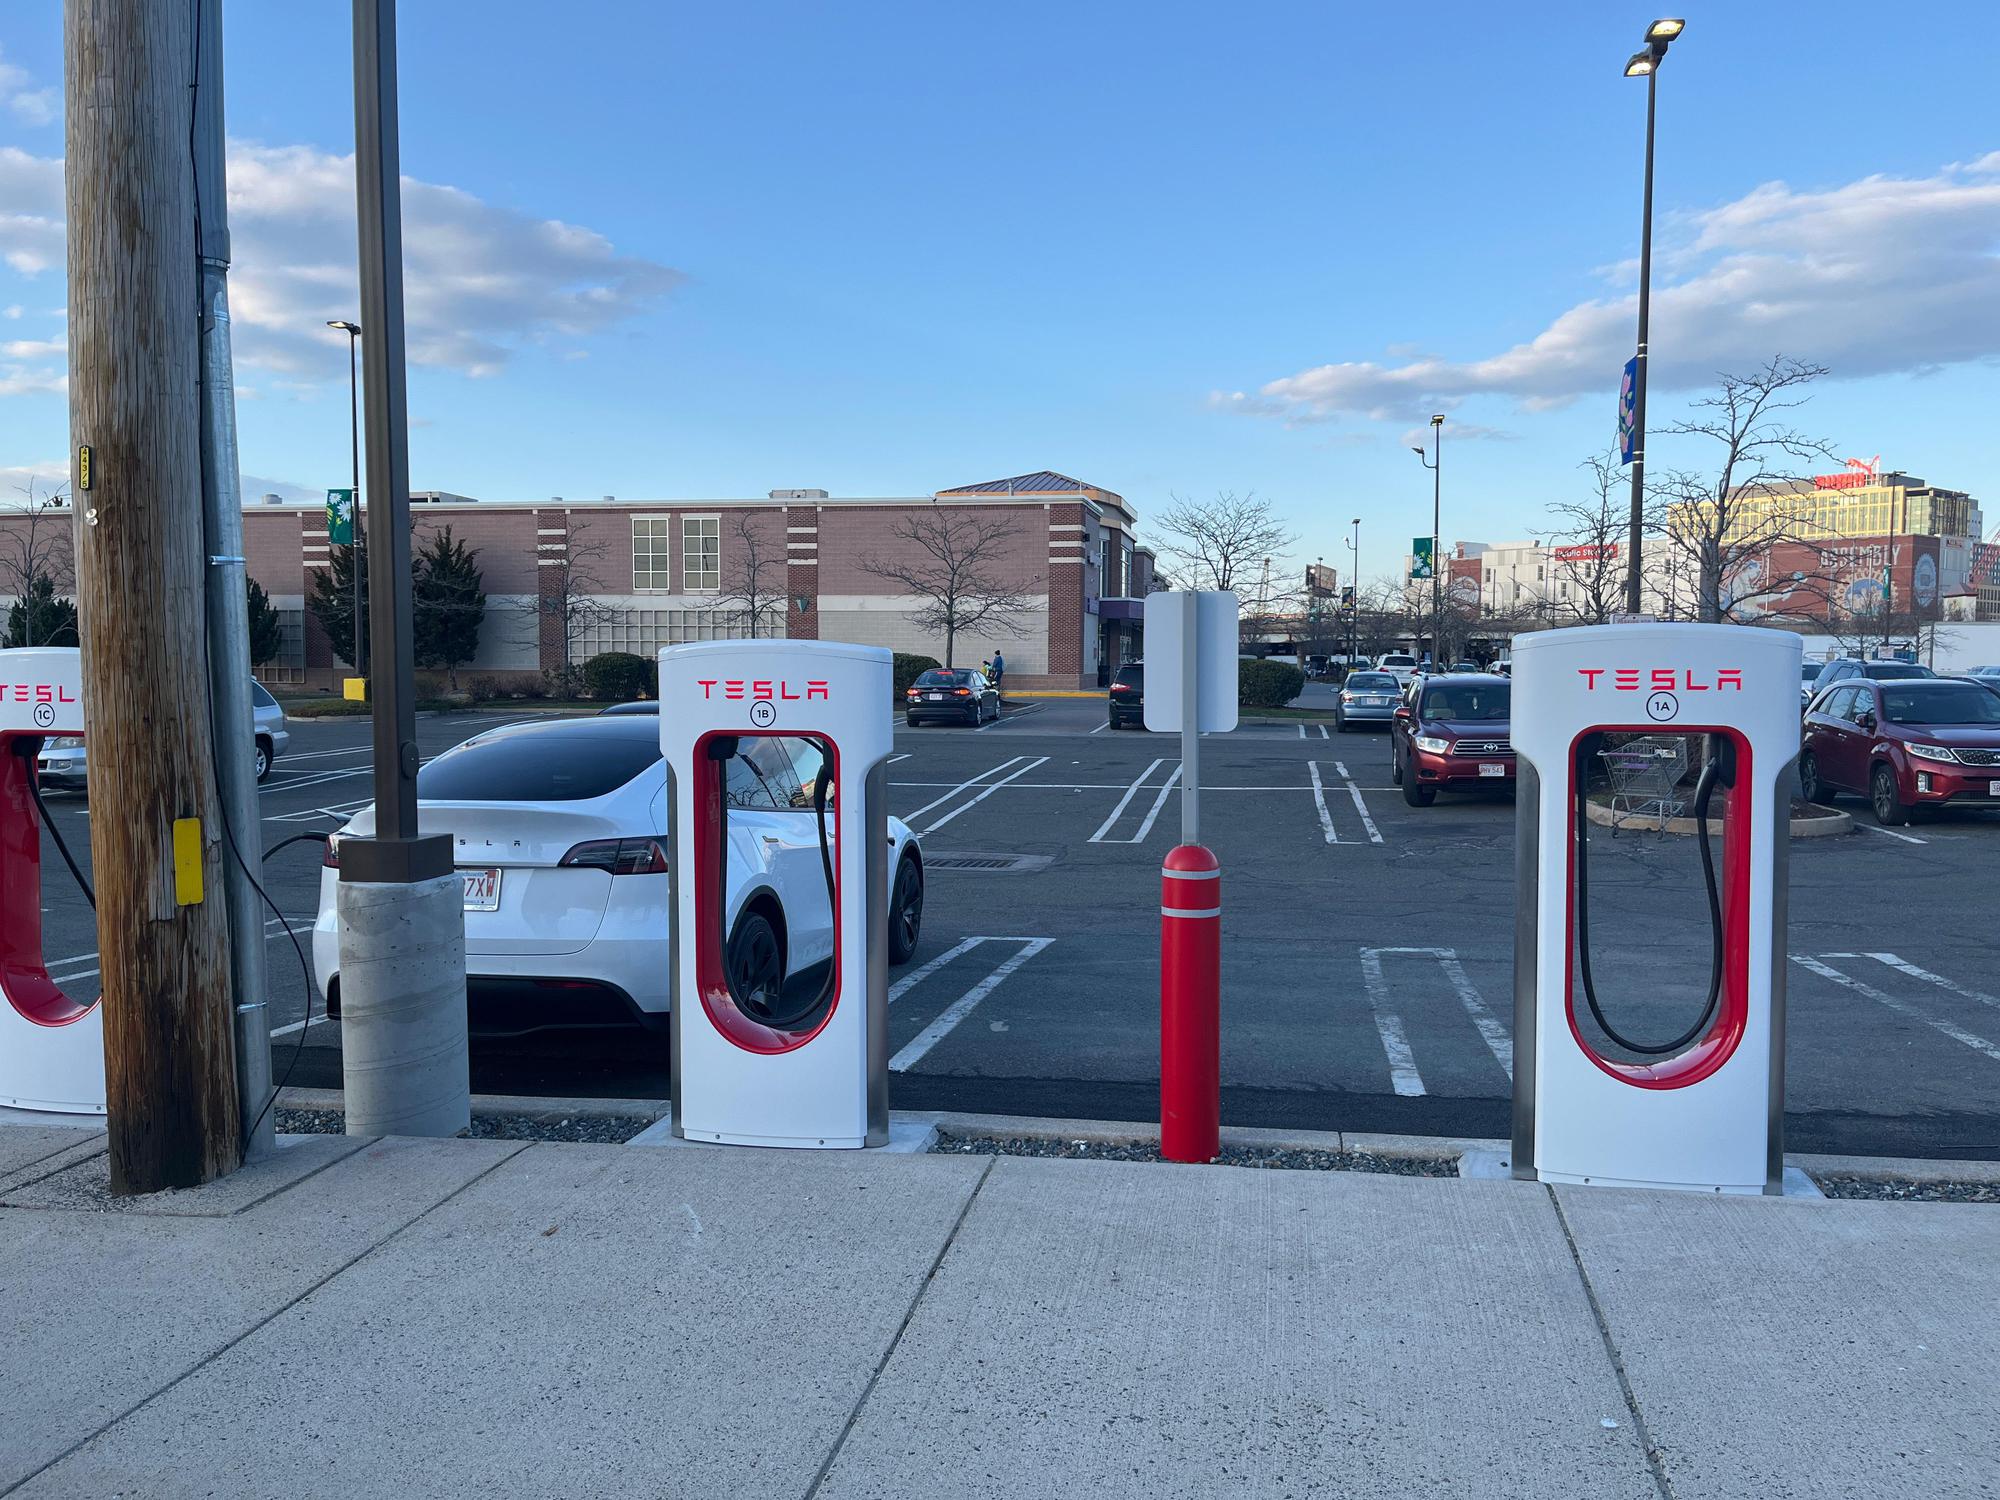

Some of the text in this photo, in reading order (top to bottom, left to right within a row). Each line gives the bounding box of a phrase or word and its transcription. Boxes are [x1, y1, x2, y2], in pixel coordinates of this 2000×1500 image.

[1577, 669, 1742, 691] TESLA
[0, 685, 76, 702] TESL
[697, 680, 828, 700] TESLA
[1655, 701, 1670, 711] 1A
[38, 710, 50, 720] 1C
[757, 709, 769, 719] 1B
[459, 839, 521, 847] SLA
[463, 878, 495, 897] 7XW
